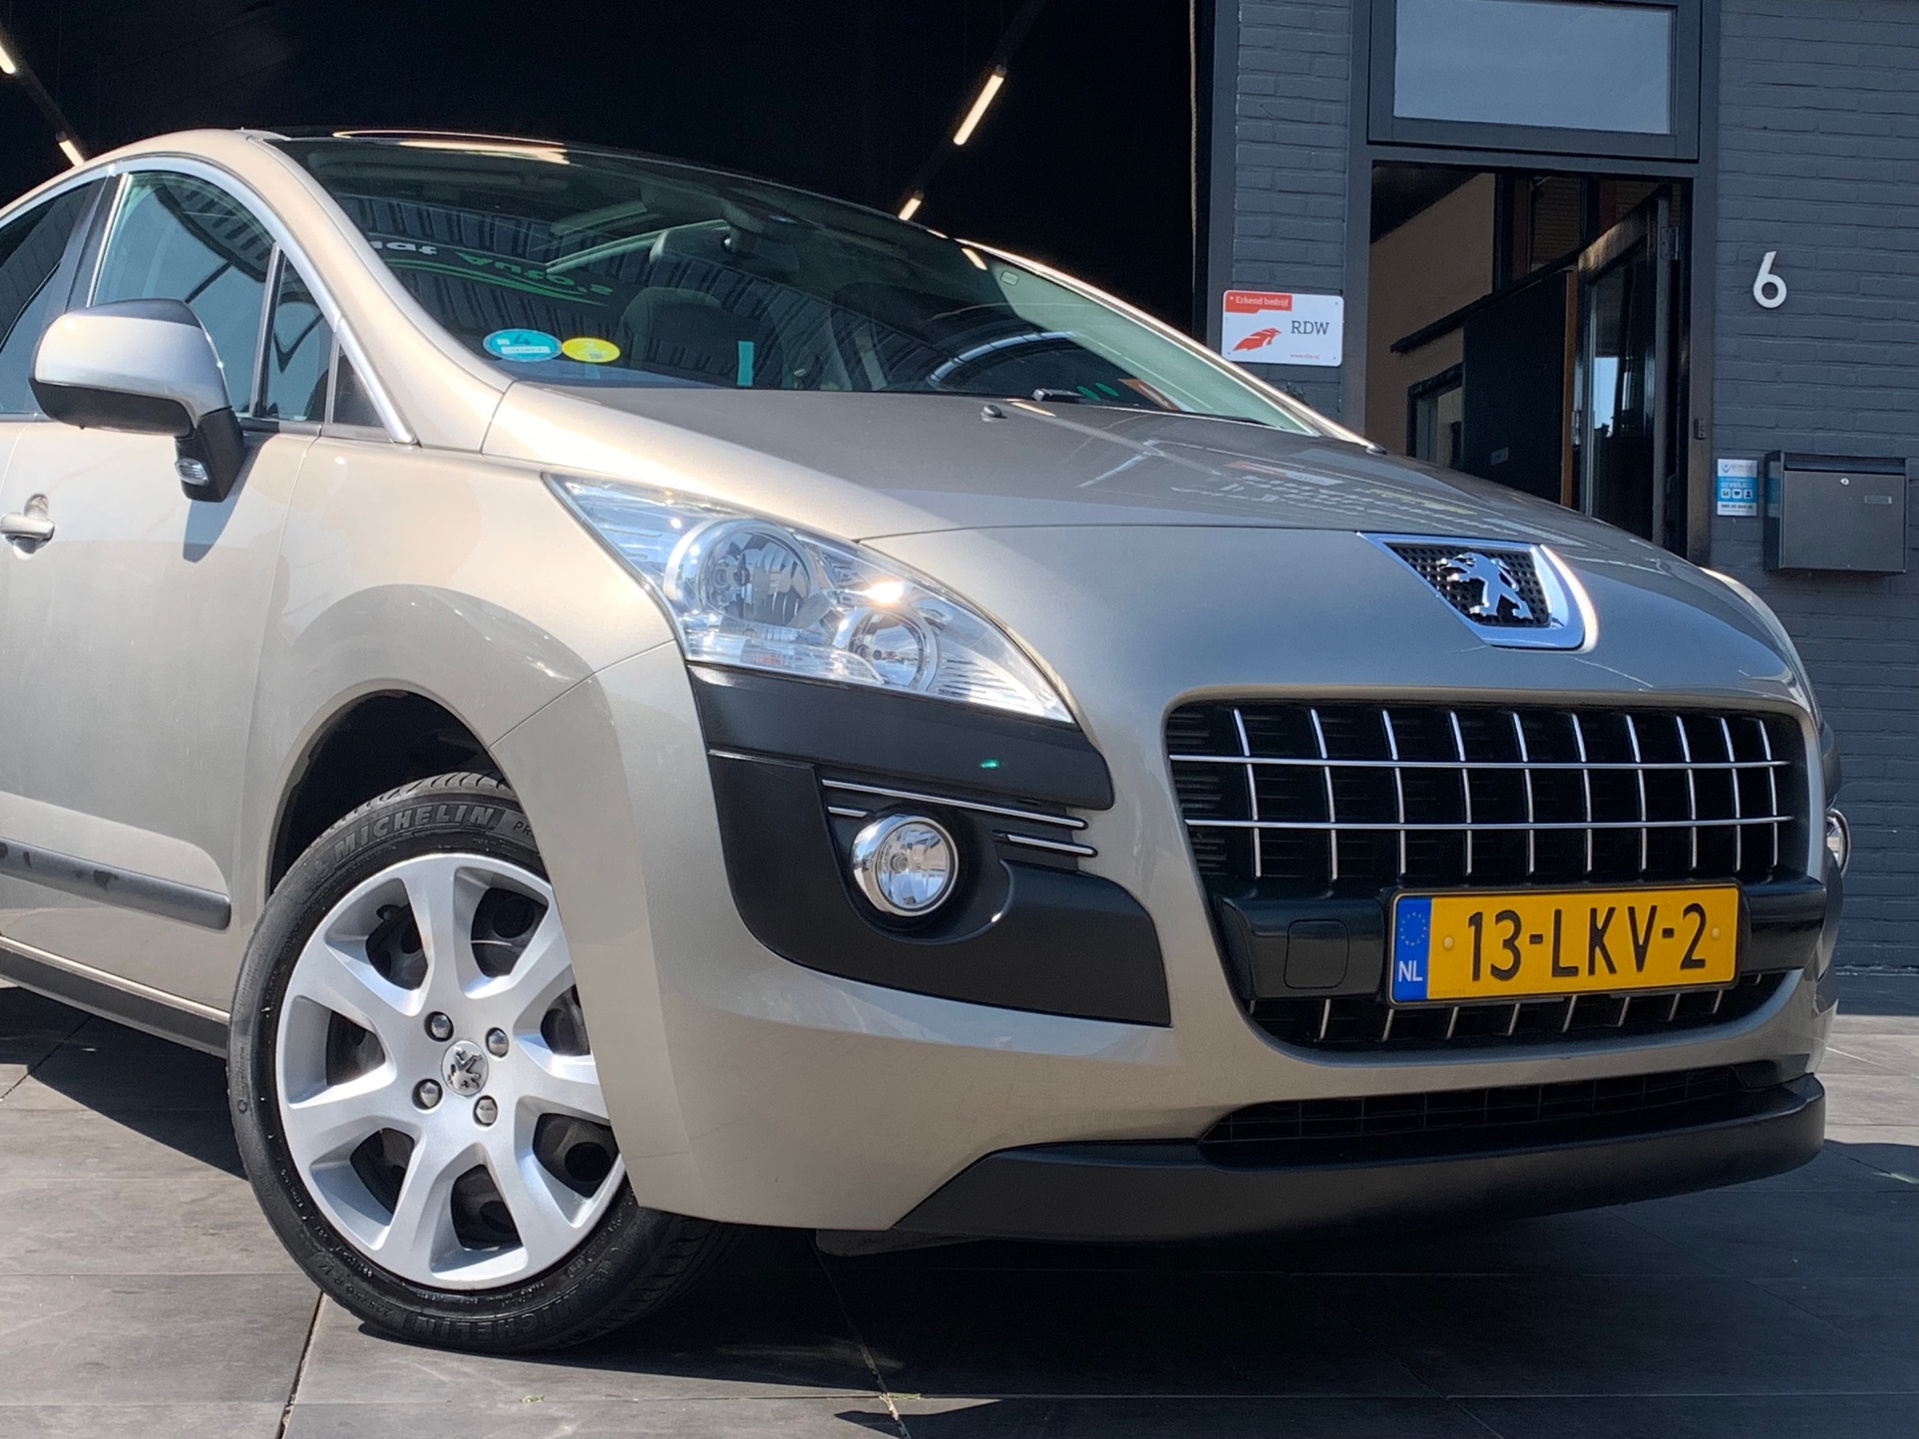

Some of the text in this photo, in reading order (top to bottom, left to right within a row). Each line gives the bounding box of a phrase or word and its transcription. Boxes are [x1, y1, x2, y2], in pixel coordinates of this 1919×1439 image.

[1753, 251, 1787, 309] 6
[1235, 296, 1289, 307] Erkend bedrijf
[1290, 320, 1330, 335] RDW
[334, 805, 494, 862] MICHELIN
[513, 821, 533, 837] PR
[1467, 902, 1707, 982] 13-LKV-2
[1398, 960, 1423, 982] NL
